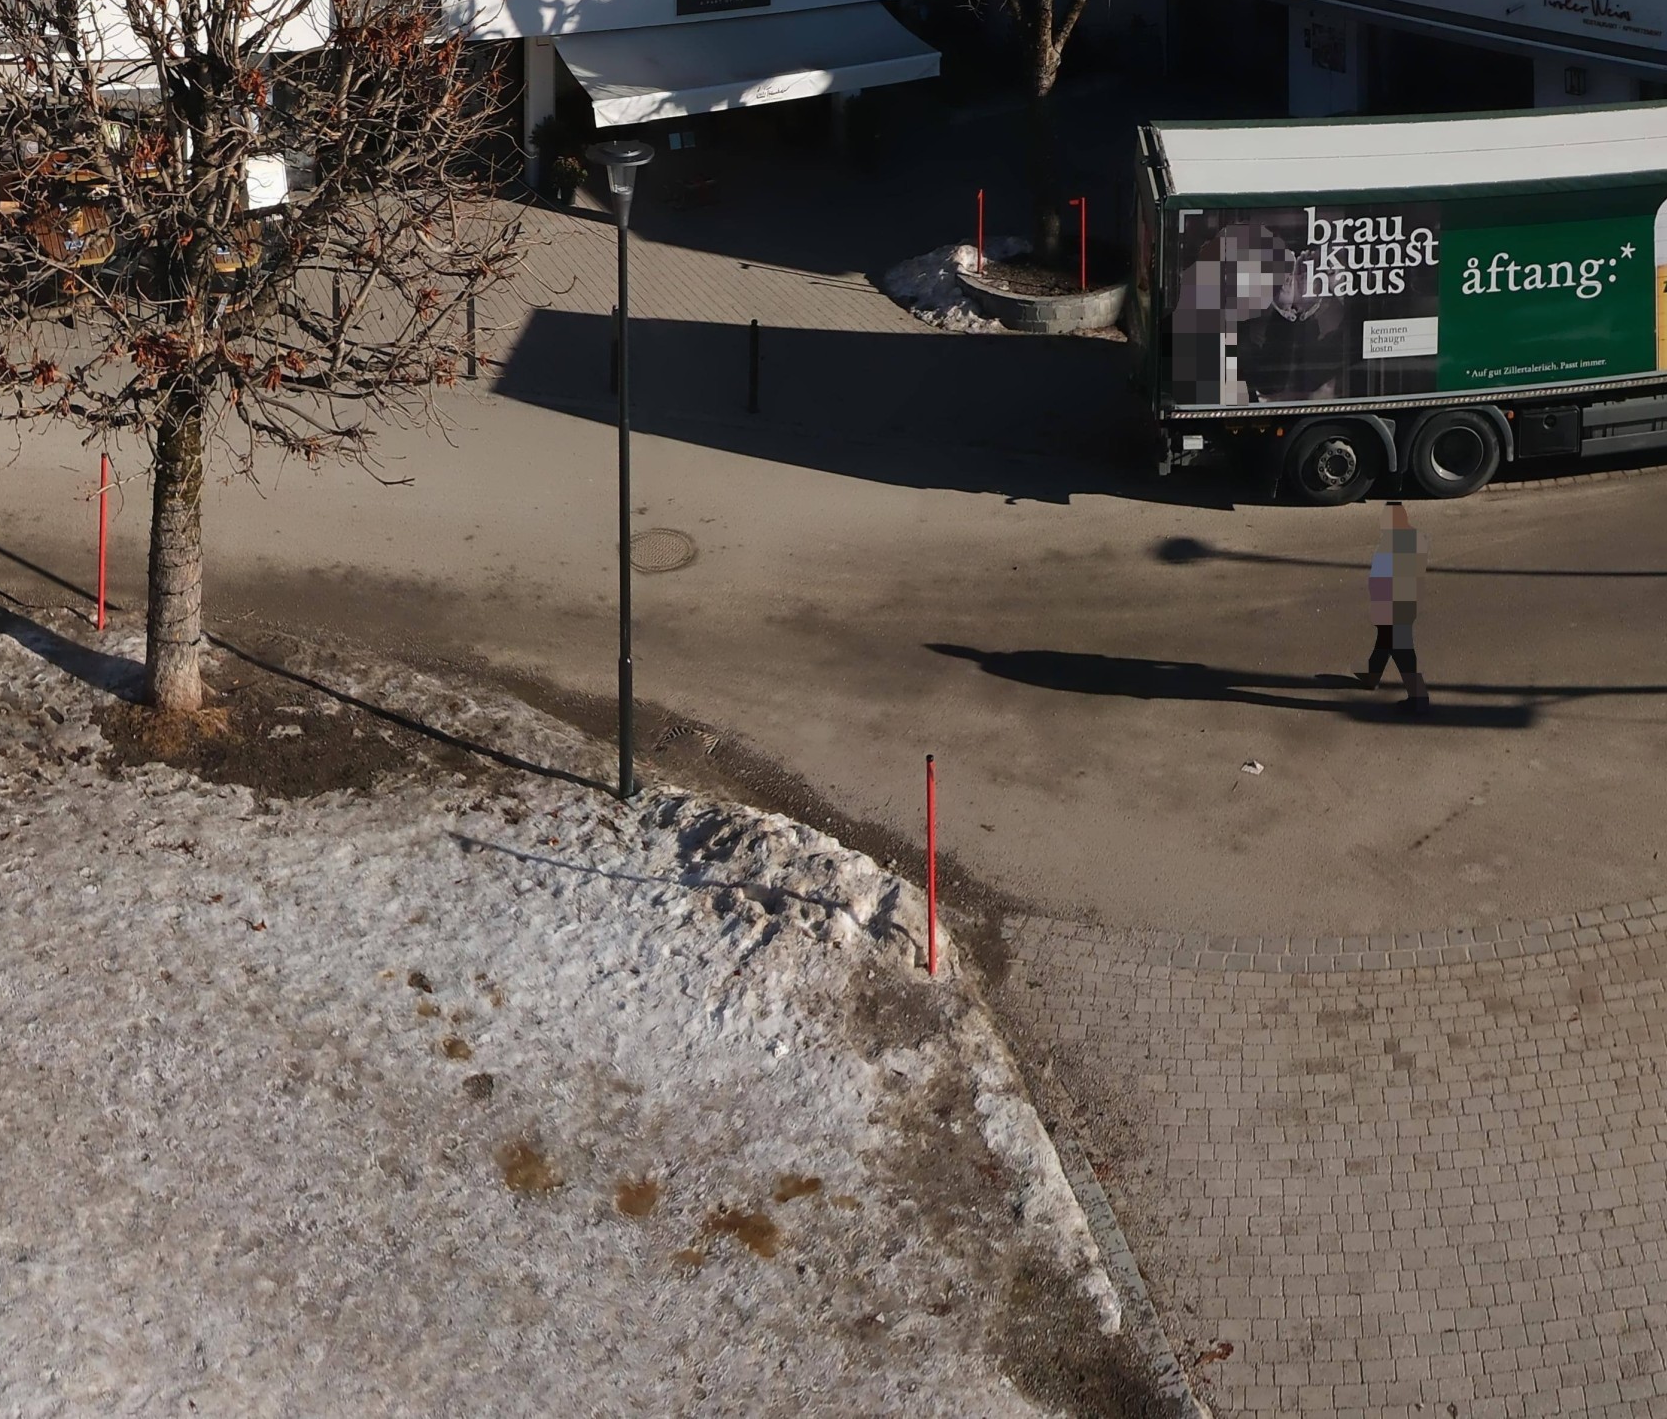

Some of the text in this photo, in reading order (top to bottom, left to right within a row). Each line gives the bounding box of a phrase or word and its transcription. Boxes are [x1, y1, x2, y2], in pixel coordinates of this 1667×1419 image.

[1303, 206, 1406, 246] brau
[1316, 227, 1439, 271] kunst
[1302, 259, 1406, 298] haus
[1370, 326, 1408, 335] kemmen
[1370, 335, 1405, 345] schaugn
[1370, 344, 1393, 353] kostn
[1471, 358, 1607, 379] Auf gut Zillertalerisch. Passt immer.
